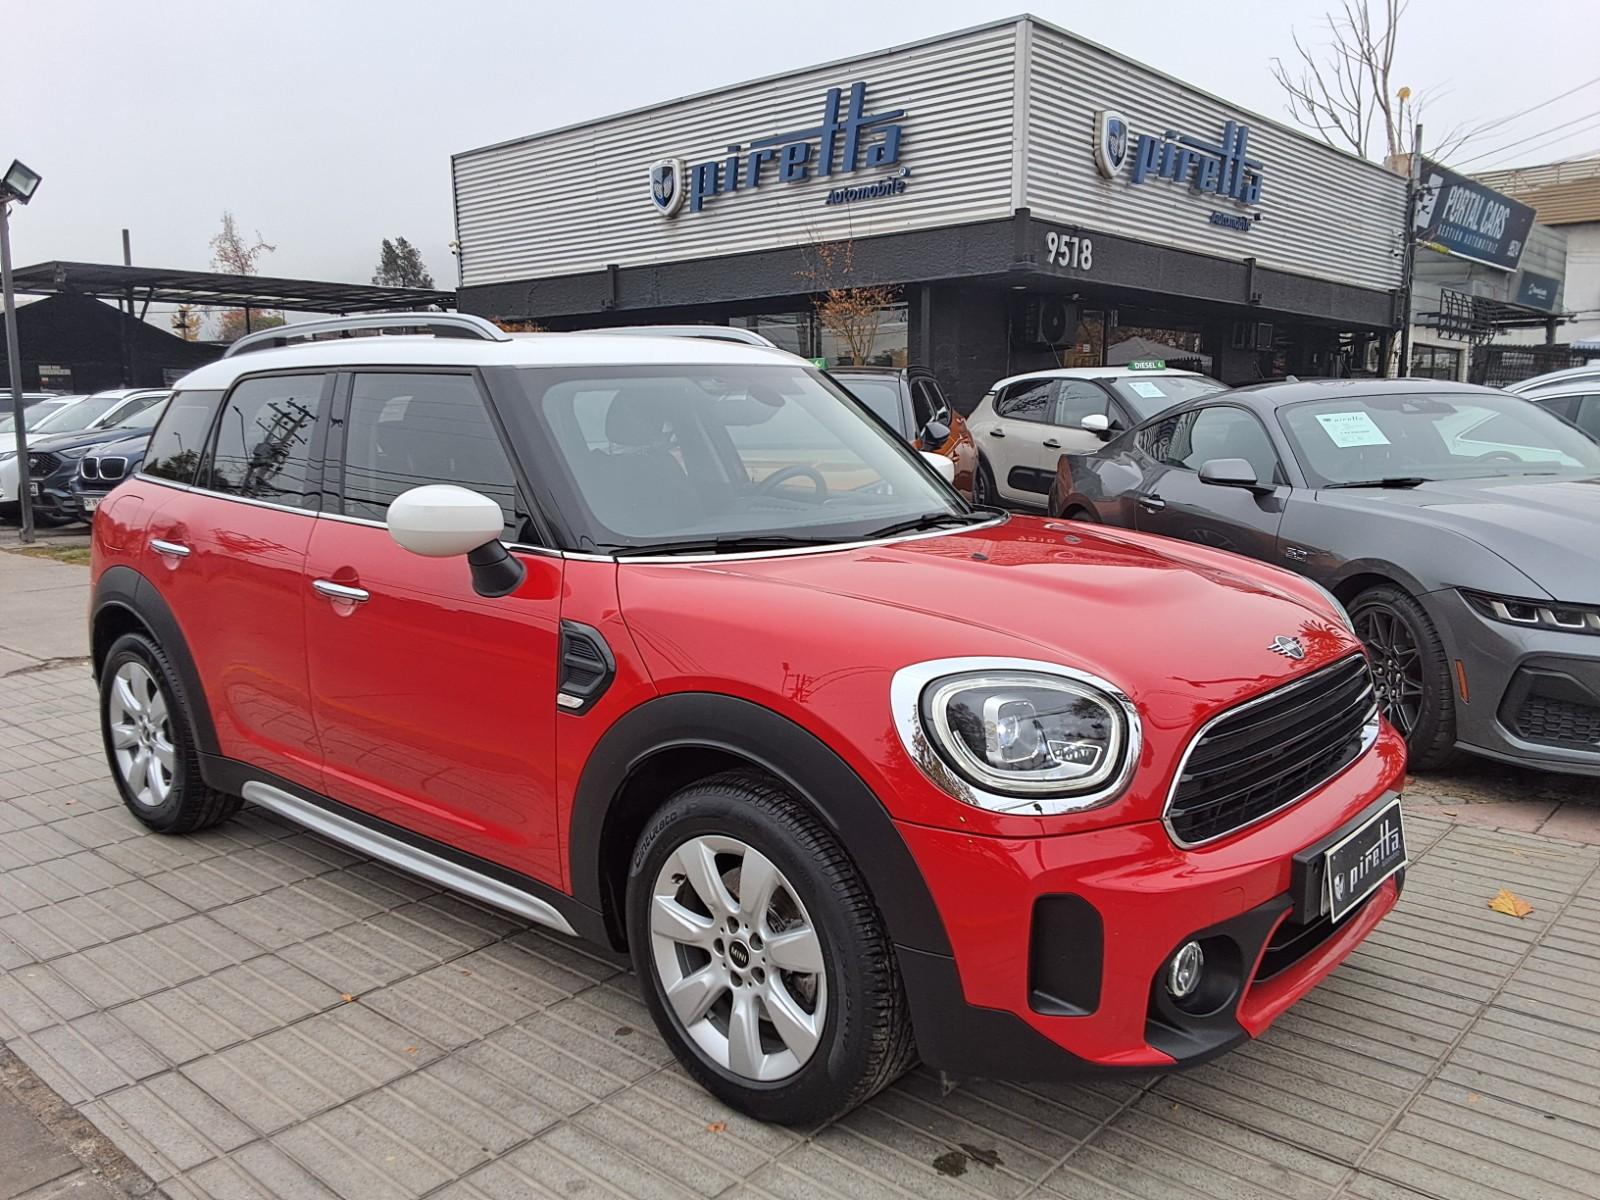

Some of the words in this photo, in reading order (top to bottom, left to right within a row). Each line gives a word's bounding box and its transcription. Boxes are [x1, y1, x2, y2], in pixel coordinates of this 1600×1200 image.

[825, 177, 906, 205] Automobile
[1442, 185, 1485, 231] PORTAL
[1480, 200, 1511, 240] CARS
[1134, 362, 1157, 370] DIESEL
[730, 945, 747, 963] MINI
